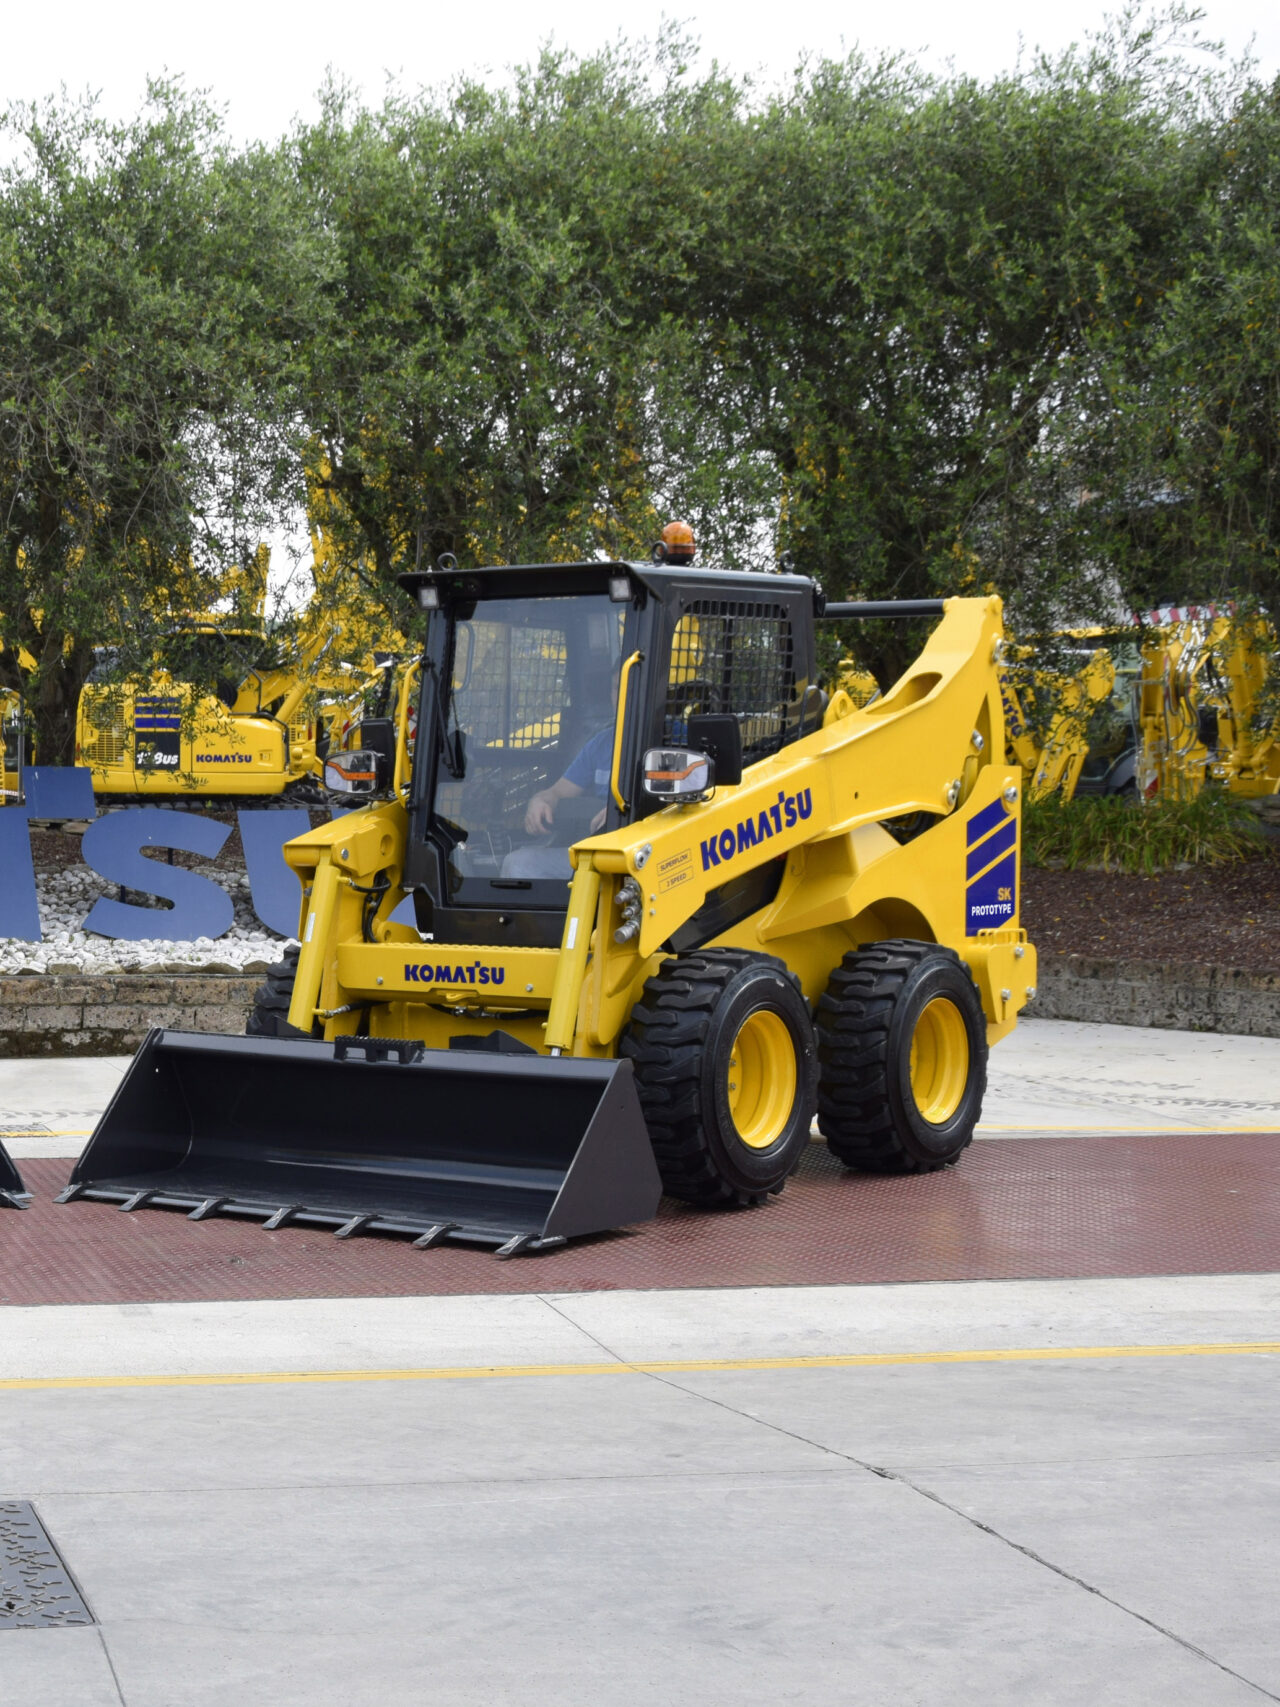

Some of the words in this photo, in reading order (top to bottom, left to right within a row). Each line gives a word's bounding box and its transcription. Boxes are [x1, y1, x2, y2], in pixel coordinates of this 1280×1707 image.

[196, 752, 252, 763] KOMATSU
[700, 787, 813, 872] KOMATSU
[660, 853, 688, 872] SUPERFLOW
[670, 872, 687, 885] SPEED
[997, 887, 1011, 901] SK
[971, 903, 1011, 916] PROTOTYPE
[404, 961, 505, 985] KOMATSU
